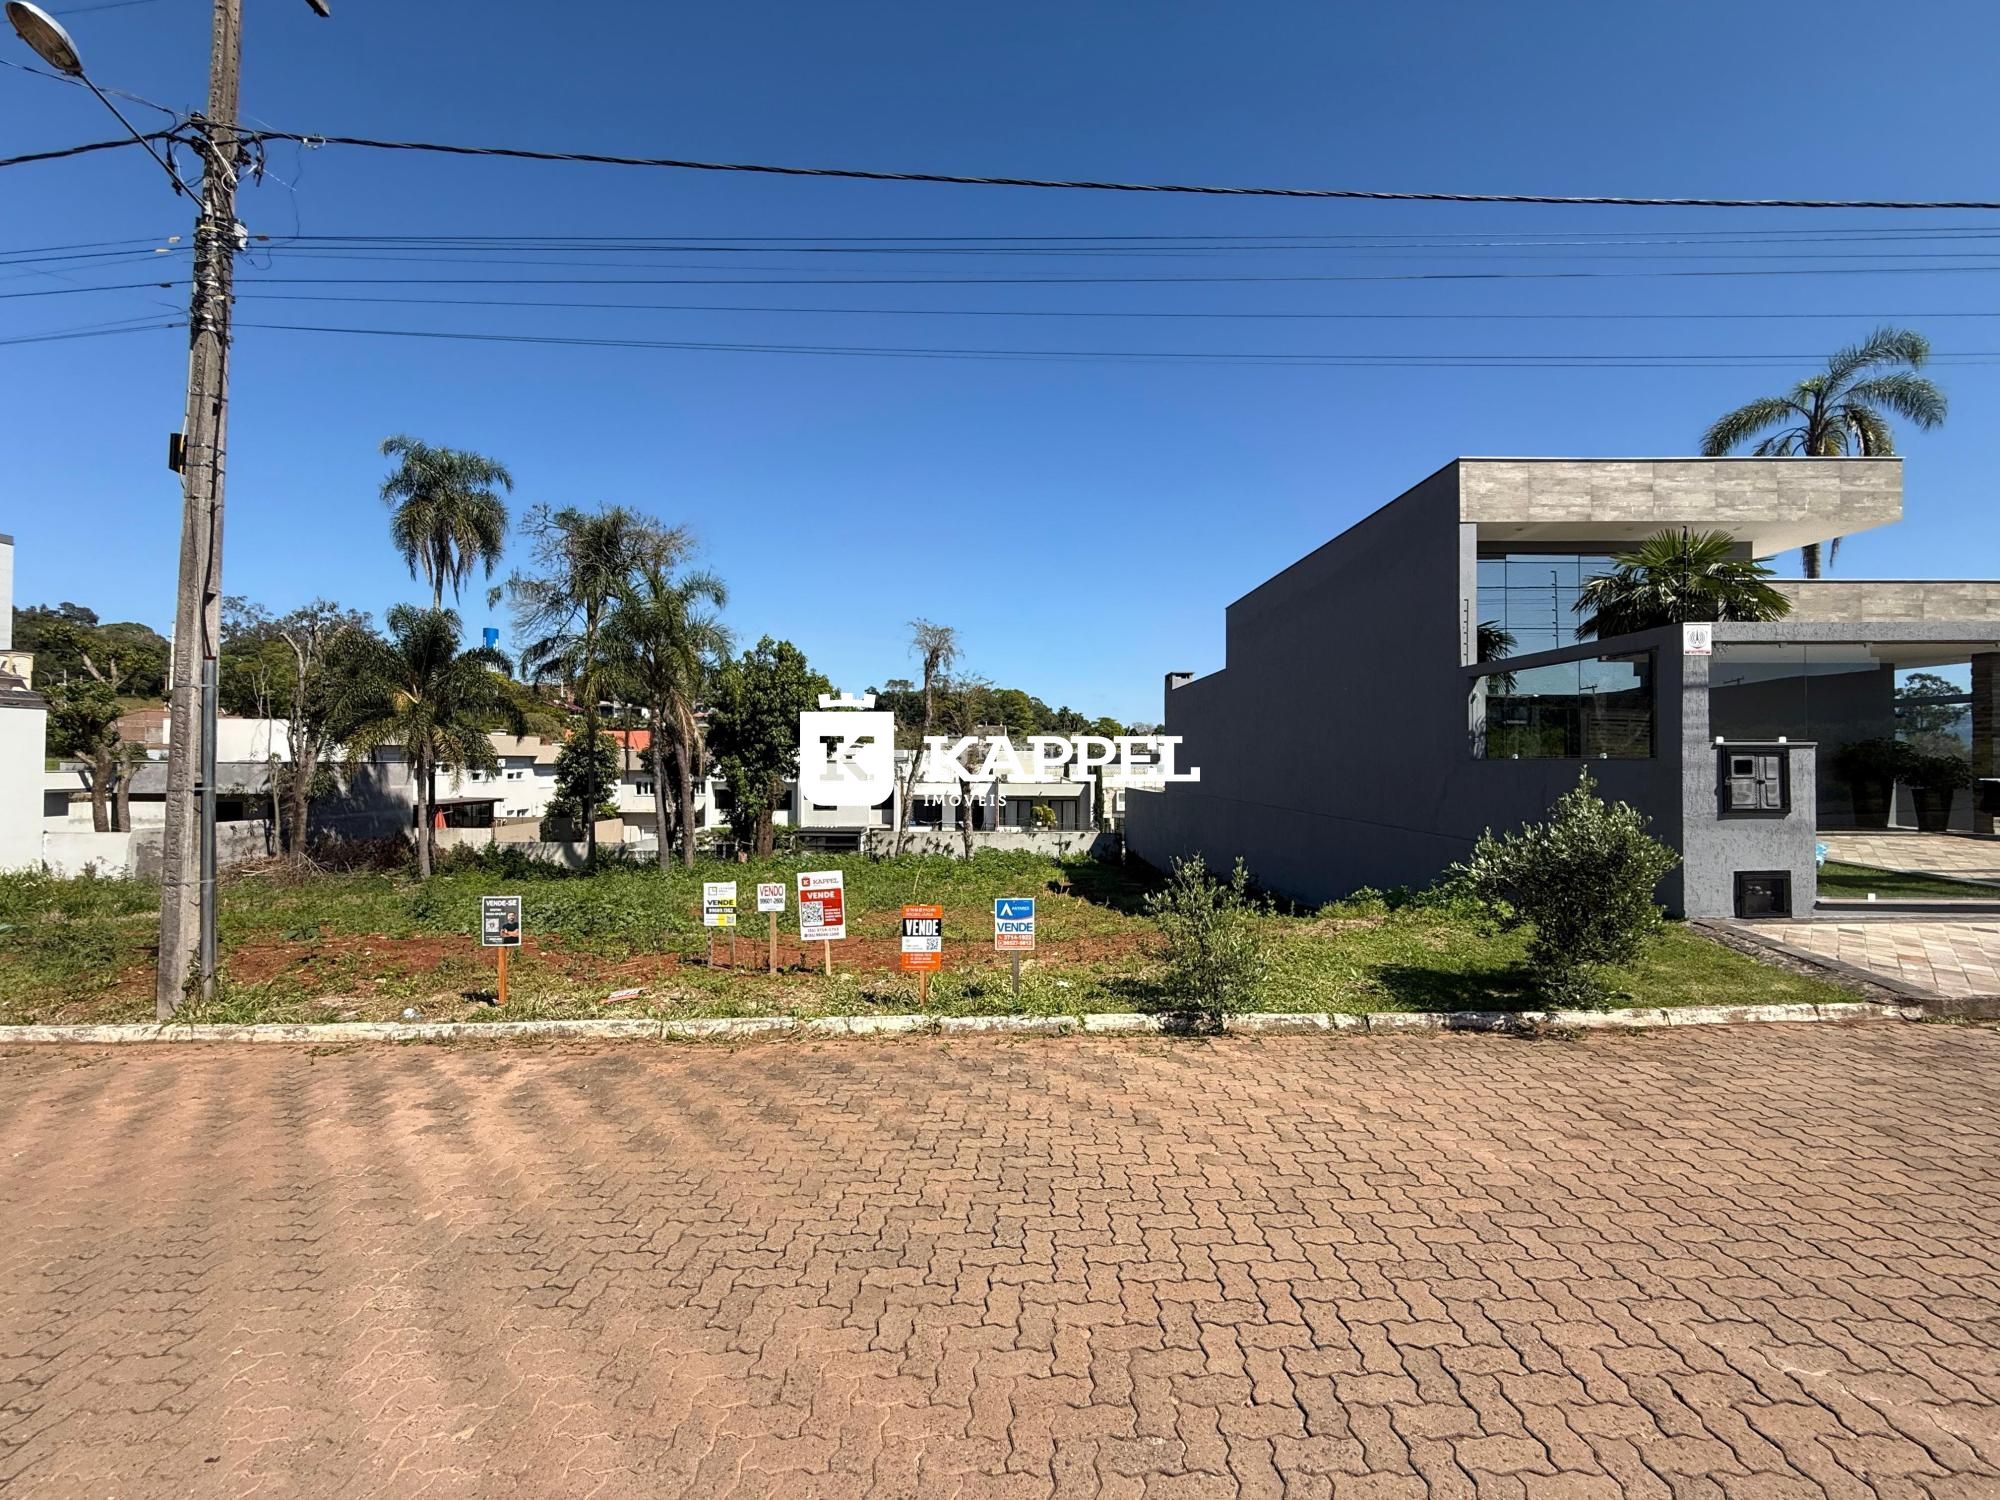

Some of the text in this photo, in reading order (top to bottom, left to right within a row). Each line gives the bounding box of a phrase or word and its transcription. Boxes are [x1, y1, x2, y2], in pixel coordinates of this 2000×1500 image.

[760, 885, 784, 897] VENDO
[807, 891, 835, 899] VENDE
[906, 919, 938, 936] VENDE
[997, 922, 1033, 932] VENDE
